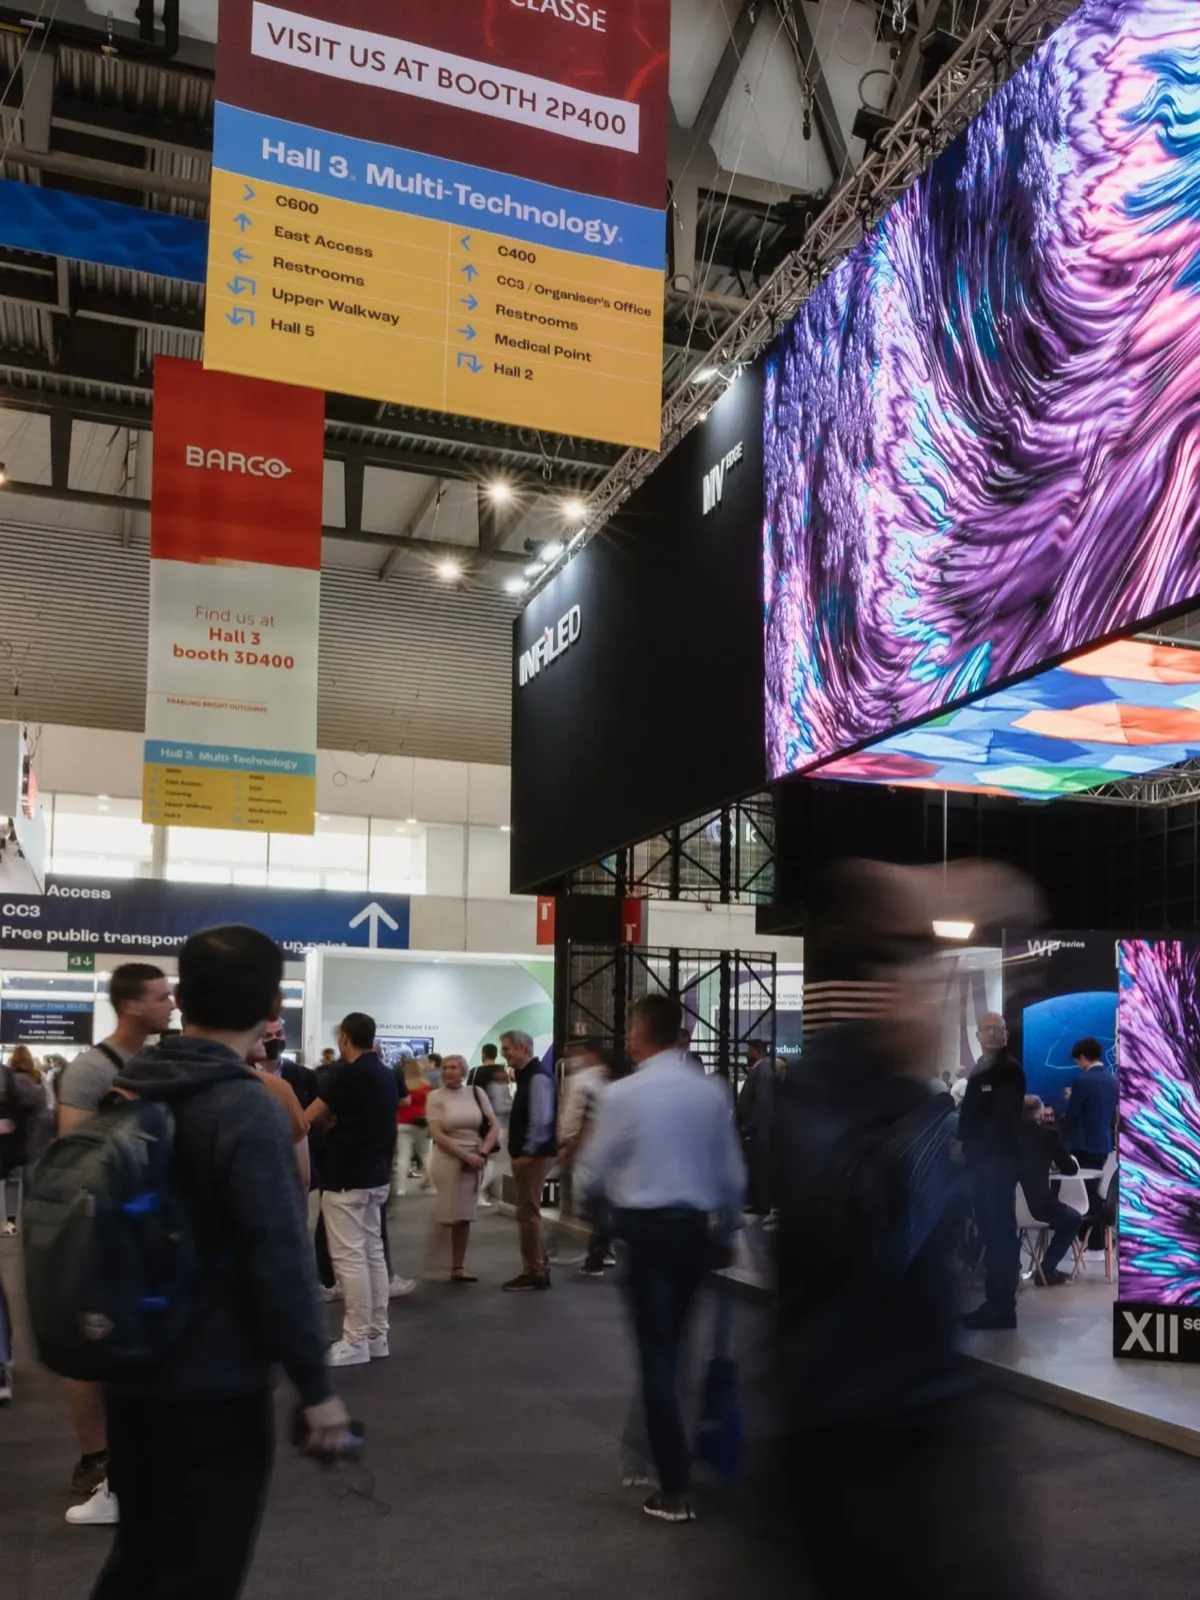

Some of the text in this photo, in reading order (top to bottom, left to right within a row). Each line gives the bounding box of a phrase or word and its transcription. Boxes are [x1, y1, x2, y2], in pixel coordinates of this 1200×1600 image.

[267, 22, 626, 135] VISIT US AT BOOTH 2P400
[262, 137, 321, 172] Hall
[275, 195, 319, 214] C600
[274, 226, 373, 258] East Access
[497, 245, 536, 264] C400
[273, 256, 365, 287] Restrooms
[272, 287, 400, 326] Upper Walkway
[496, 275, 524, 290] CC3
[535, 284, 610, 309] Organiser's
[613, 300, 652, 317] Office
[271, 318, 315, 337] Hall 5
[495, 304, 579, 331] Restrooms
[495, 333, 592, 363] Medical Point
[494, 362, 533, 380] Hall 2
[186, 445, 292, 479] BARCO
[195, 605, 276, 628] Find us at
[209, 627, 261, 645] Hall 3
[173, 644, 295, 669] booth 3D400
[160, 748, 183, 759] Hall
[47, 884, 111, 900] Access
[2, 903, 41, 917] CC3
[1, 925, 43, 940] Free
[47, 928, 100, 943] public
[283, 942, 303, 953] up
[1027, 939, 1086, 956] WP series
[1121, 1311, 1179, 1354] XII
